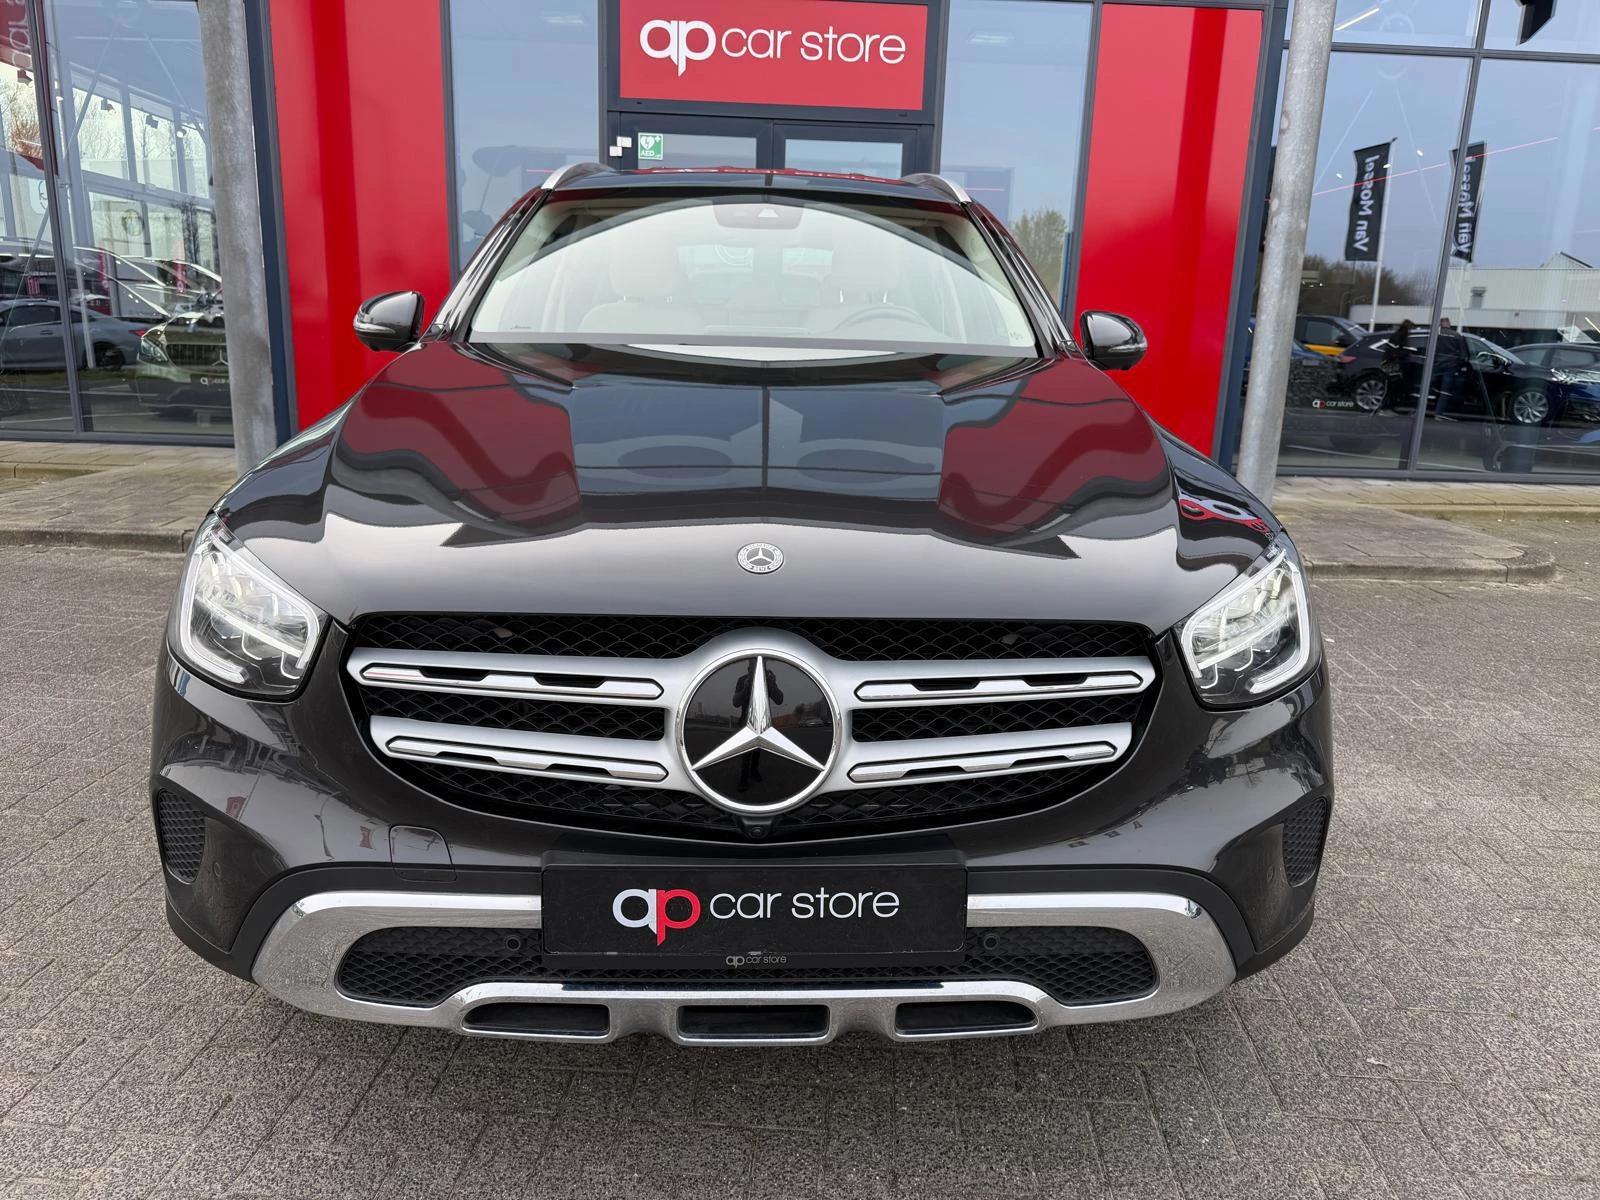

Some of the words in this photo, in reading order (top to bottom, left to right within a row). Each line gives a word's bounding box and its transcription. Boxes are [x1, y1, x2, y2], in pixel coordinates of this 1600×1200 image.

[639, 20, 717, 77] ap
[721, 27, 792, 59] car
[800, 26, 906, 64] store
[612, 887, 702, 947] ap
[710, 892, 782, 920] car
[791, 887, 900, 919] store
[725, 955, 745, 968] ap
[746, 956, 761, 964] car
[763, 955, 787, 964] store
